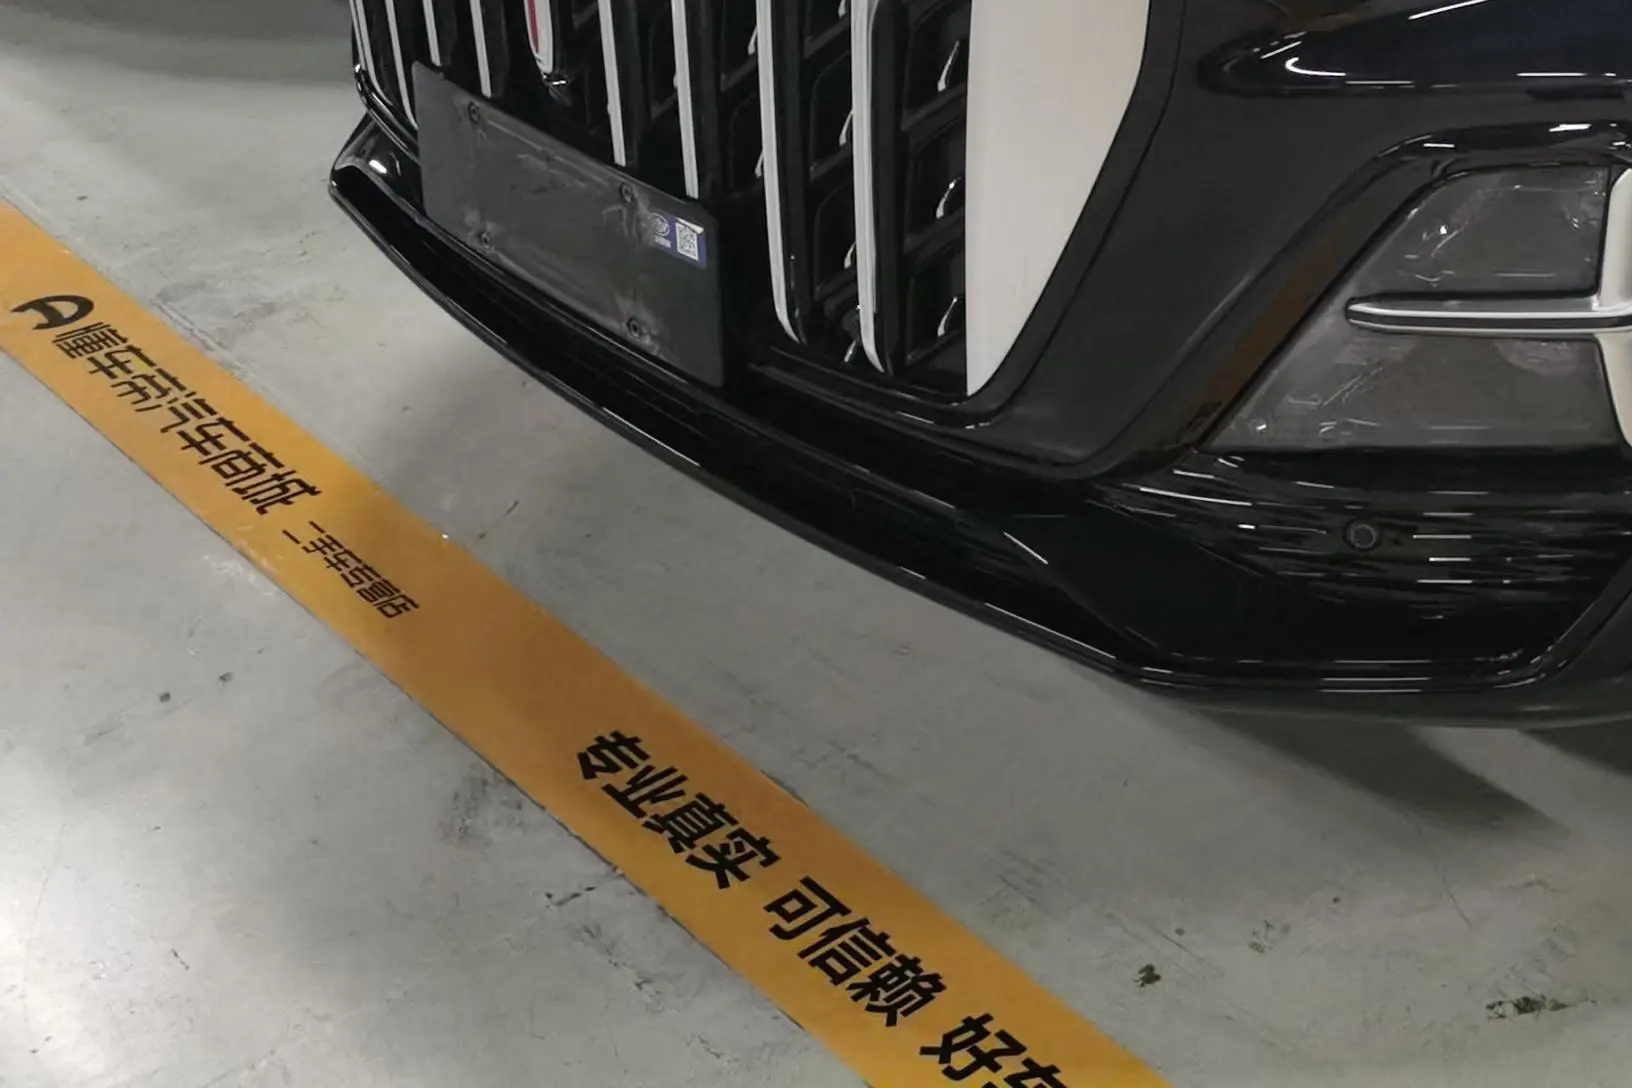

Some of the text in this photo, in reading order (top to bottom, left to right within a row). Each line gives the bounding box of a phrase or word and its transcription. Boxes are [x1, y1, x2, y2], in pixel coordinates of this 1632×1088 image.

[51, 321, 421, 618] 懂车帝汽车商城 二手车专营店
[576, 729, 781, 890] 专业真实
[763, 875, 947, 1028] 可信赖
